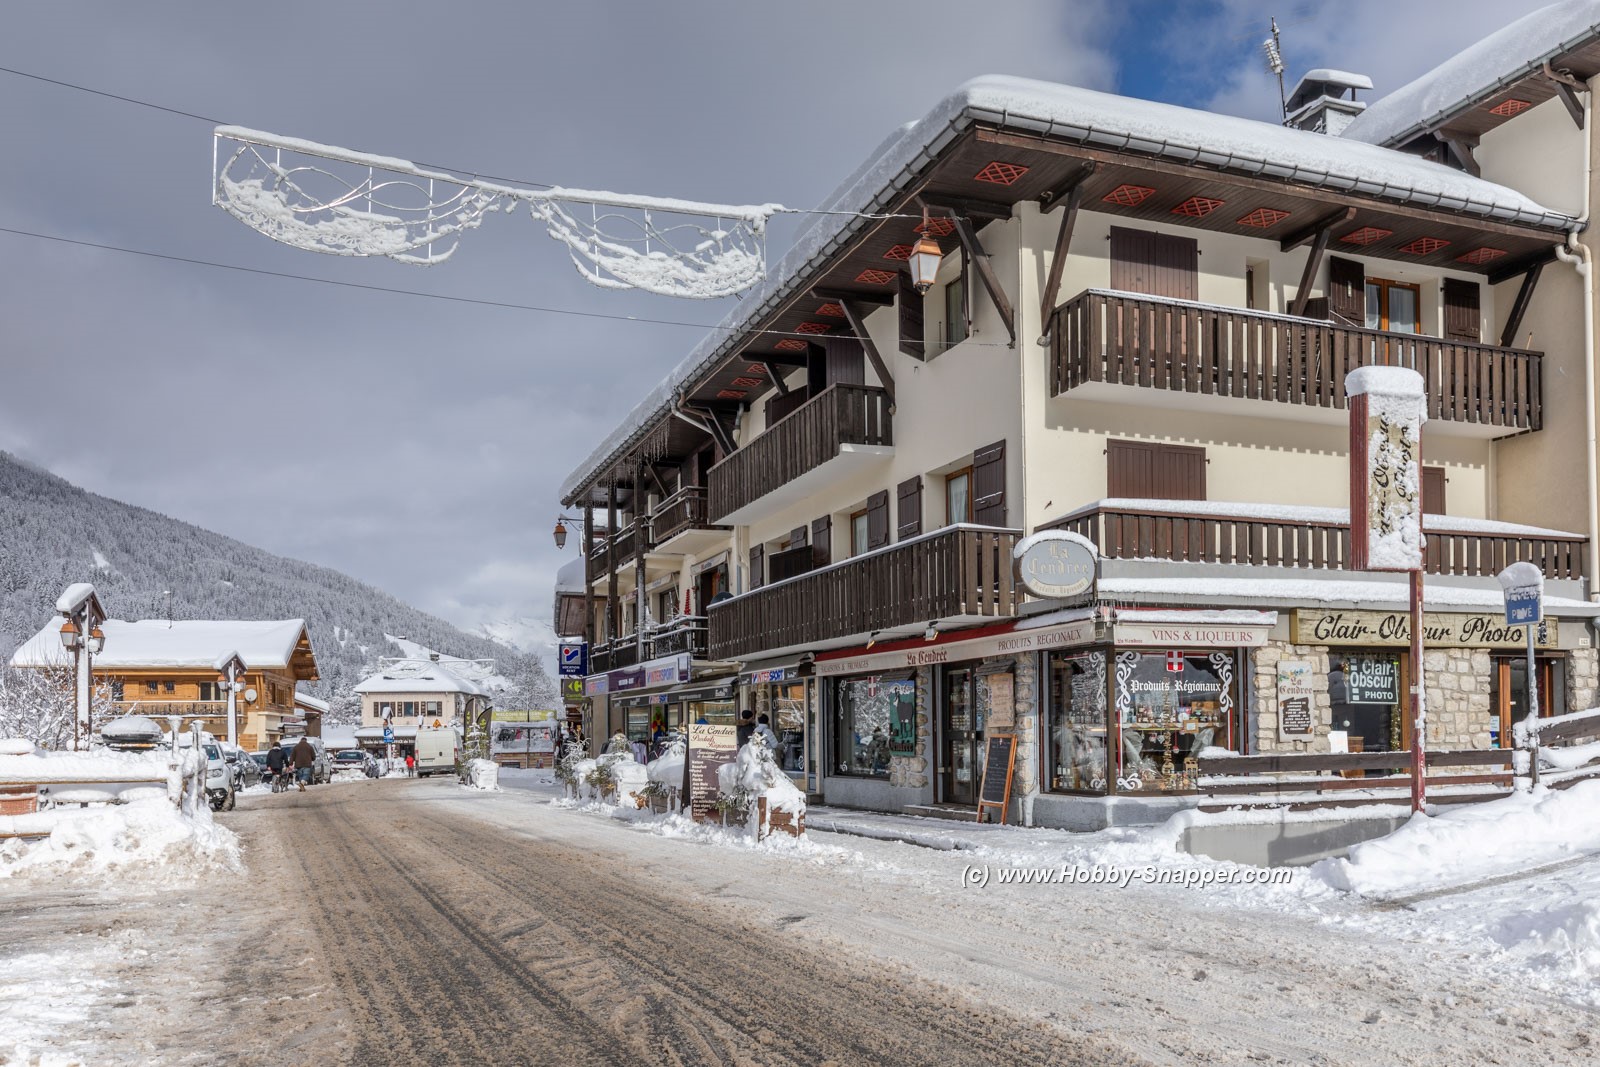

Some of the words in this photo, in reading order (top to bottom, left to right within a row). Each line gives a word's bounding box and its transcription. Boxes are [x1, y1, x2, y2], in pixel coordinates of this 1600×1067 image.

[1050, 542, 1068, 559] La
[1511, 605, 1533, 619] PVÉ
[1152, 630, 1180, 641] VINS
[1183, 630, 1192, 641] &
[1196, 631, 1253, 643] LIQUEURS
[1460, 617, 1522, 643] Photo
[998, 636, 1032, 651] PRODUITS
[907, 651, 916, 665] La
[918, 646, 948, 664] Cendrée
[1362, 659, 1394, 676] Clair-
[1130, 680, 1170, 693] Produits
[1175, 679, 1221, 694] Régionaux
[1290, 677, 1302, 686] La
[1350, 671, 1393, 689] Obscur
[1364, 690, 1394, 700] PHOTO
[691, 725, 705, 734] La
[707, 726, 736, 736] Cendrée
